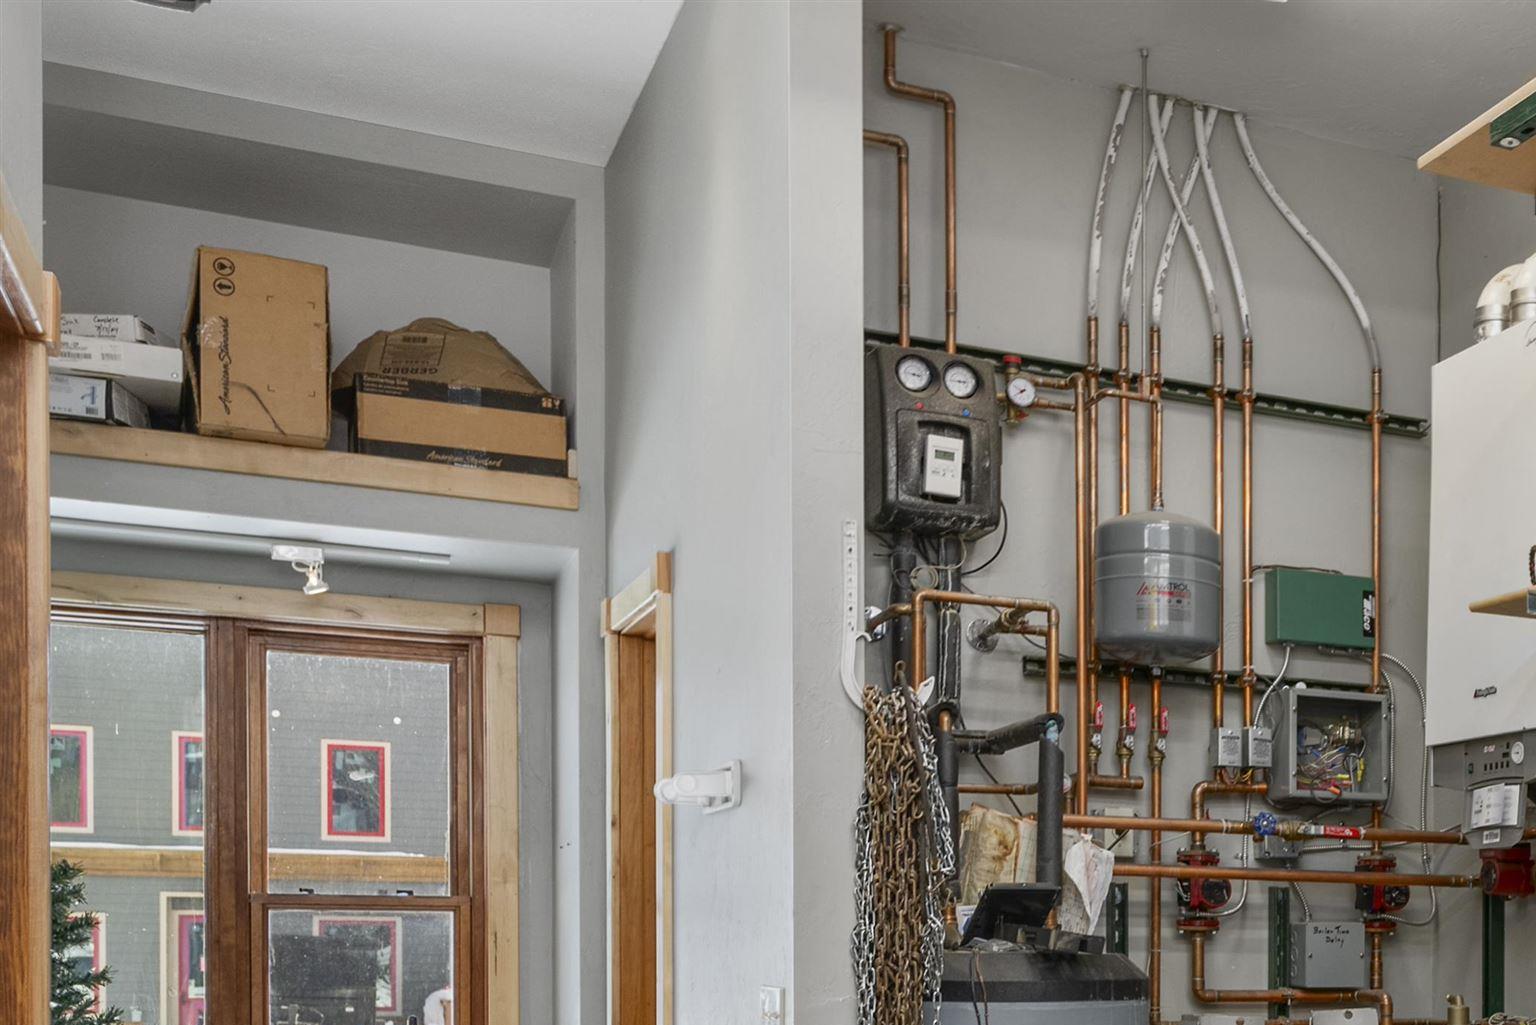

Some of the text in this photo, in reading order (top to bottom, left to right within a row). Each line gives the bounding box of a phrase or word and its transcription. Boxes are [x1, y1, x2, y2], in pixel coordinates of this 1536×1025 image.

[218, 316, 232, 415] American Standard
[382, 366, 439, 375] GERBER
